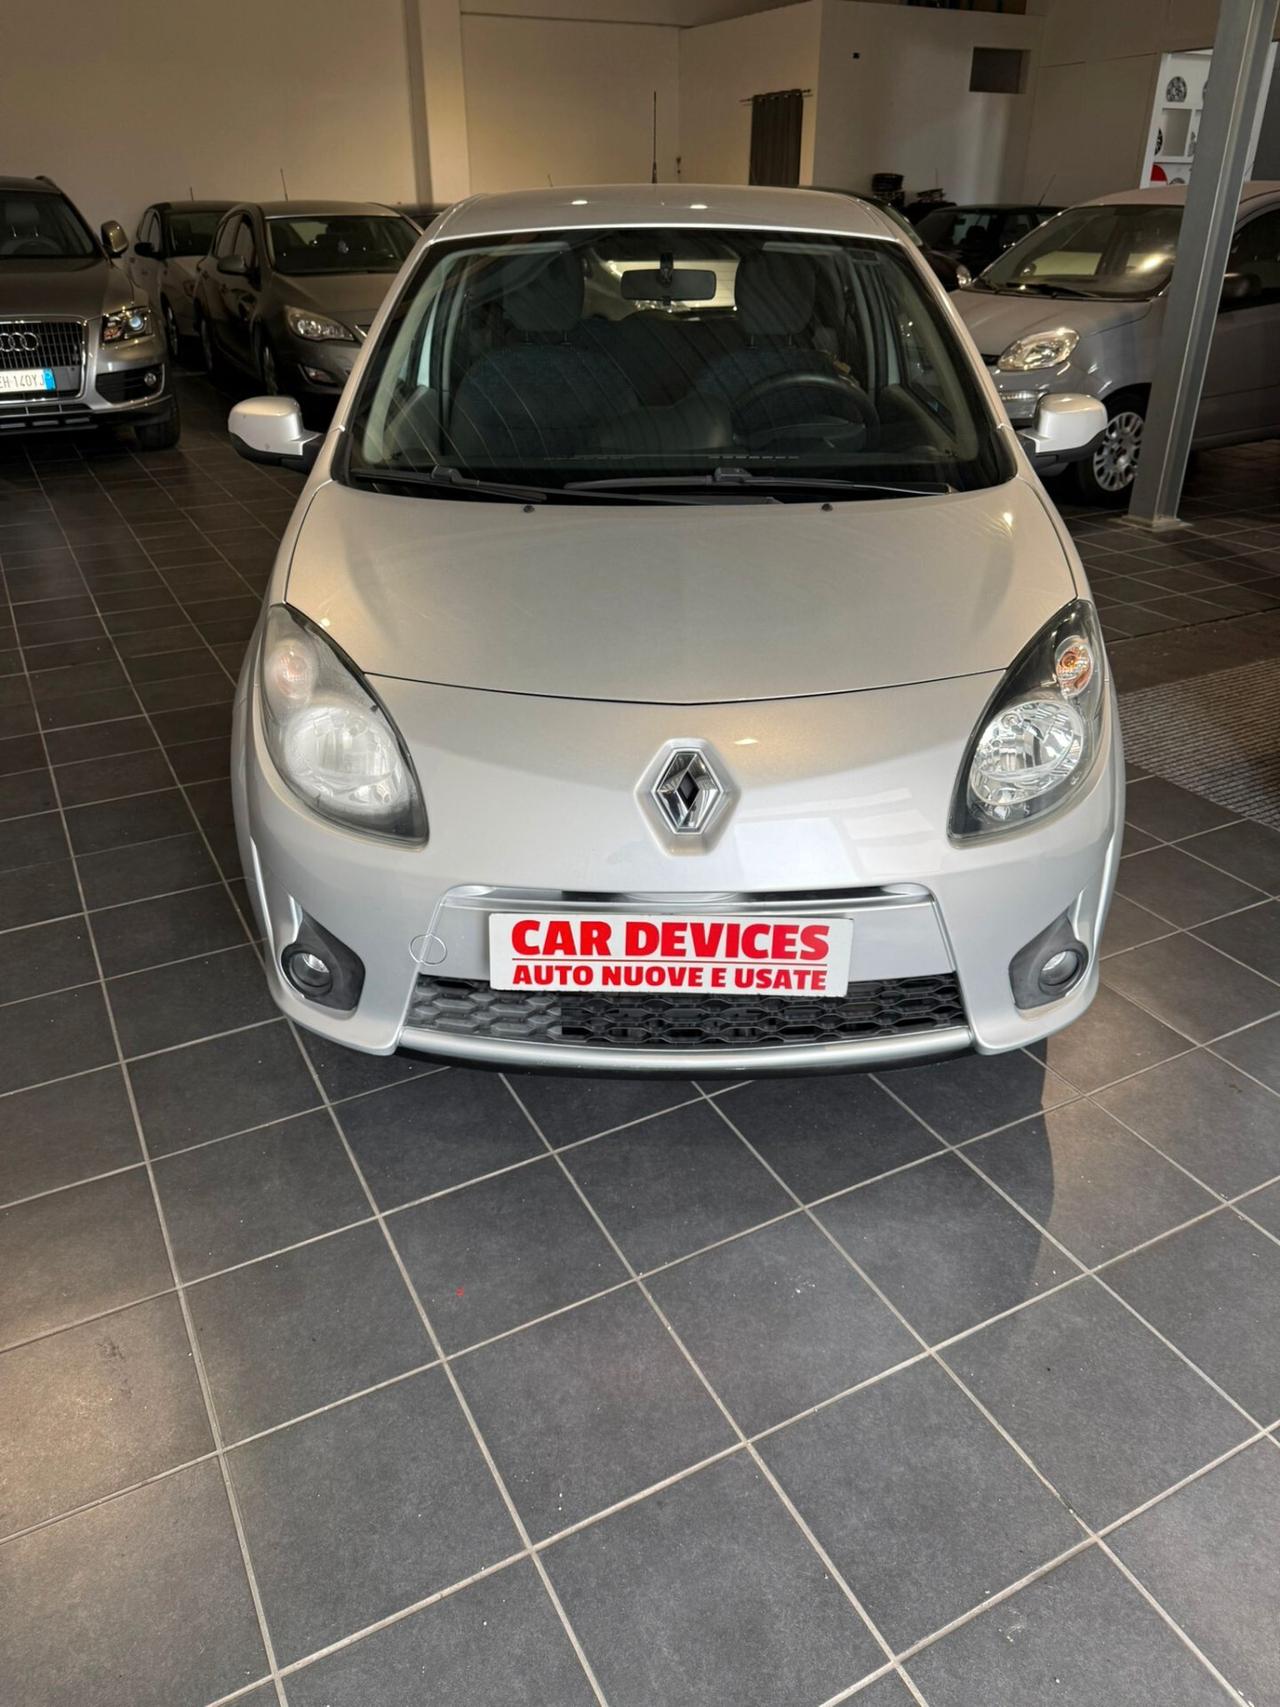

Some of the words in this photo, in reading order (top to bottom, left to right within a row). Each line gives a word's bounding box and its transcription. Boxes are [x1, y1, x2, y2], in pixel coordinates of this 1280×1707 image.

[511, 919, 612, 956] CAR
[625, 921, 830, 960] DEVICES
[512, 965, 594, 985] AUTO
[601, 966, 704, 987] NUOVE
[711, 967, 727, 988] E
[734, 968, 828, 991] USATE
